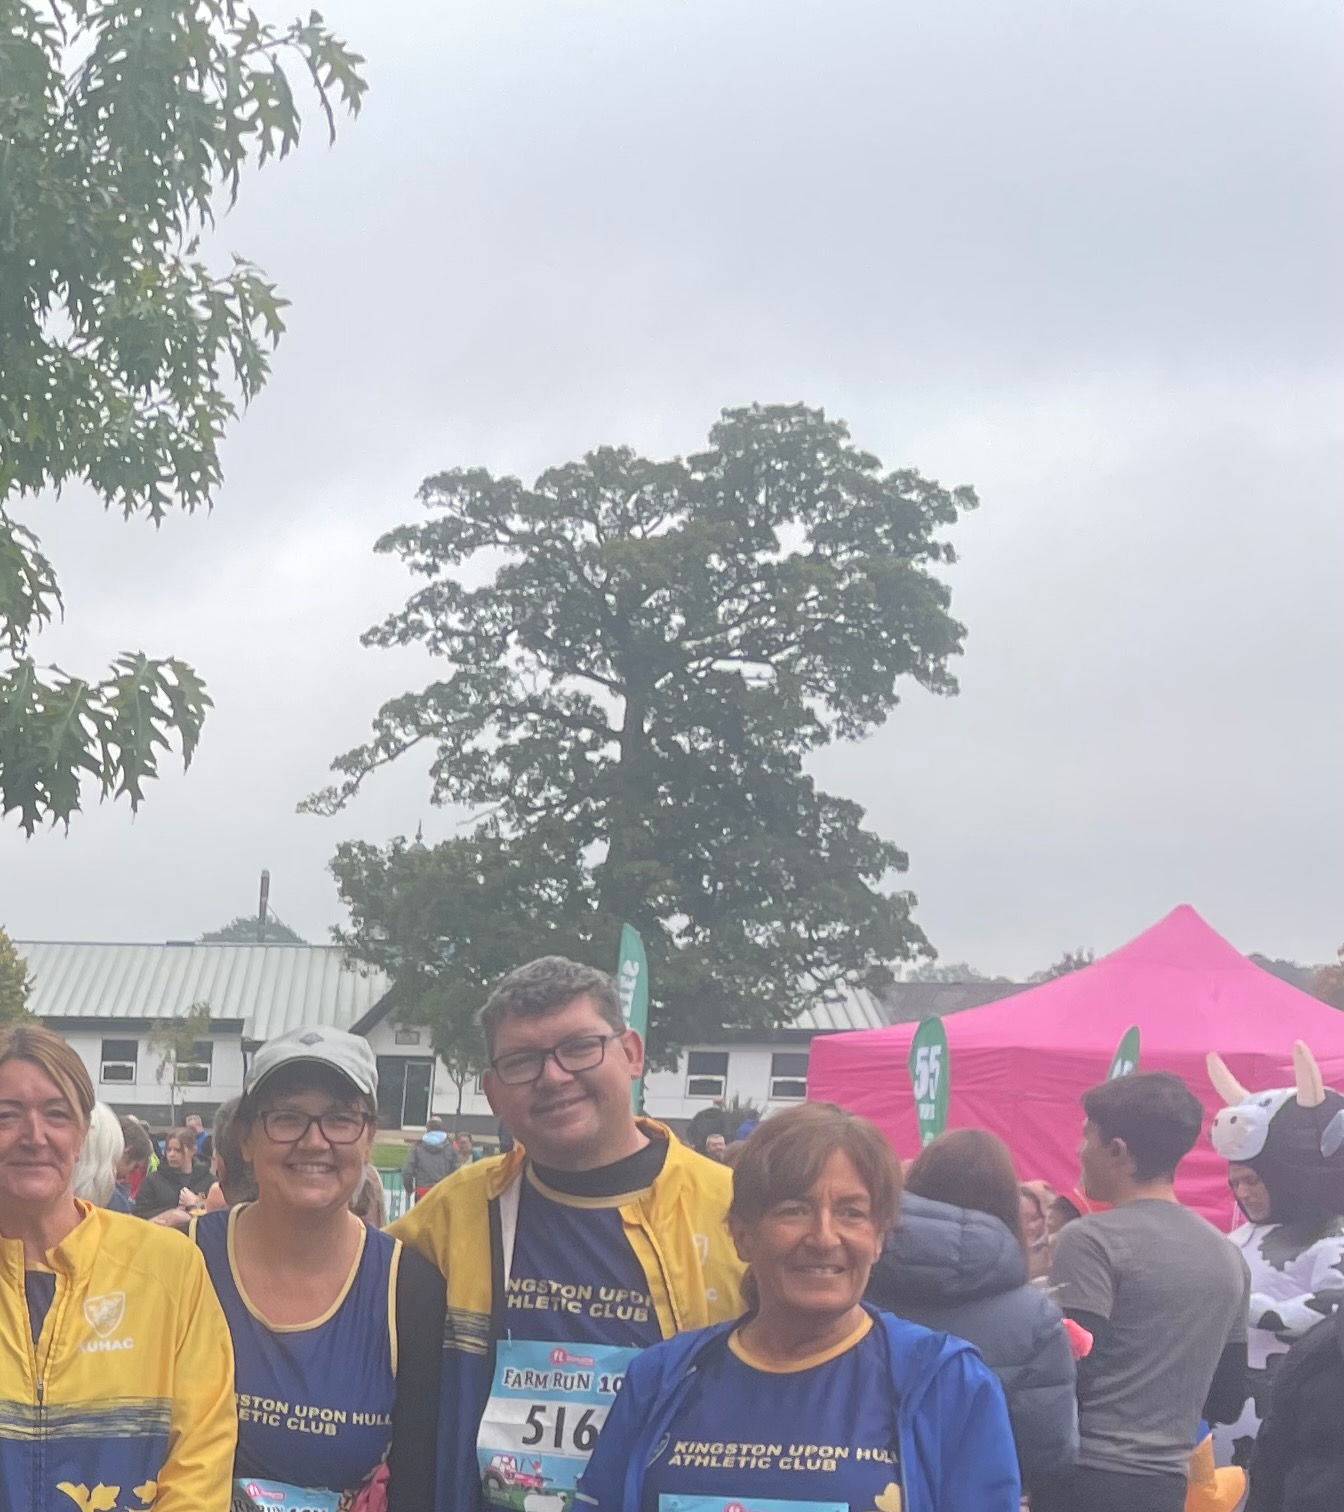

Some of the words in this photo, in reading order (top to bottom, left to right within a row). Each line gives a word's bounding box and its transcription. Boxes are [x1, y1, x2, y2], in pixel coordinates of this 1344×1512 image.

[914, 1044, 942, 1100] 55
[506, 1279, 592, 1299] NGSTON
[507, 1295, 582, 1314] HLETIC
[589, 1303, 649, 1322] CLUB
[504, 1369, 548, 1389] FARM
[553, 1372, 590, 1391] RUN
[599, 1376, 624, 1392] 10
[236, 1393, 288, 1414] STON
[295, 1404, 347, 1423] UPON
[352, 1412, 392, 1426] HULL
[239, 1409, 281, 1427] ETIC
[287, 1418, 336, 1436] CLUB
[522, 1405, 599, 1451] 516
[668, 1454, 771, 1469] ATHLETIC
[779, 1458, 836, 1472] CLUB
[674, 1441, 782, 1456] KINGSTON
[789, 1444, 849, 1459] UPON
